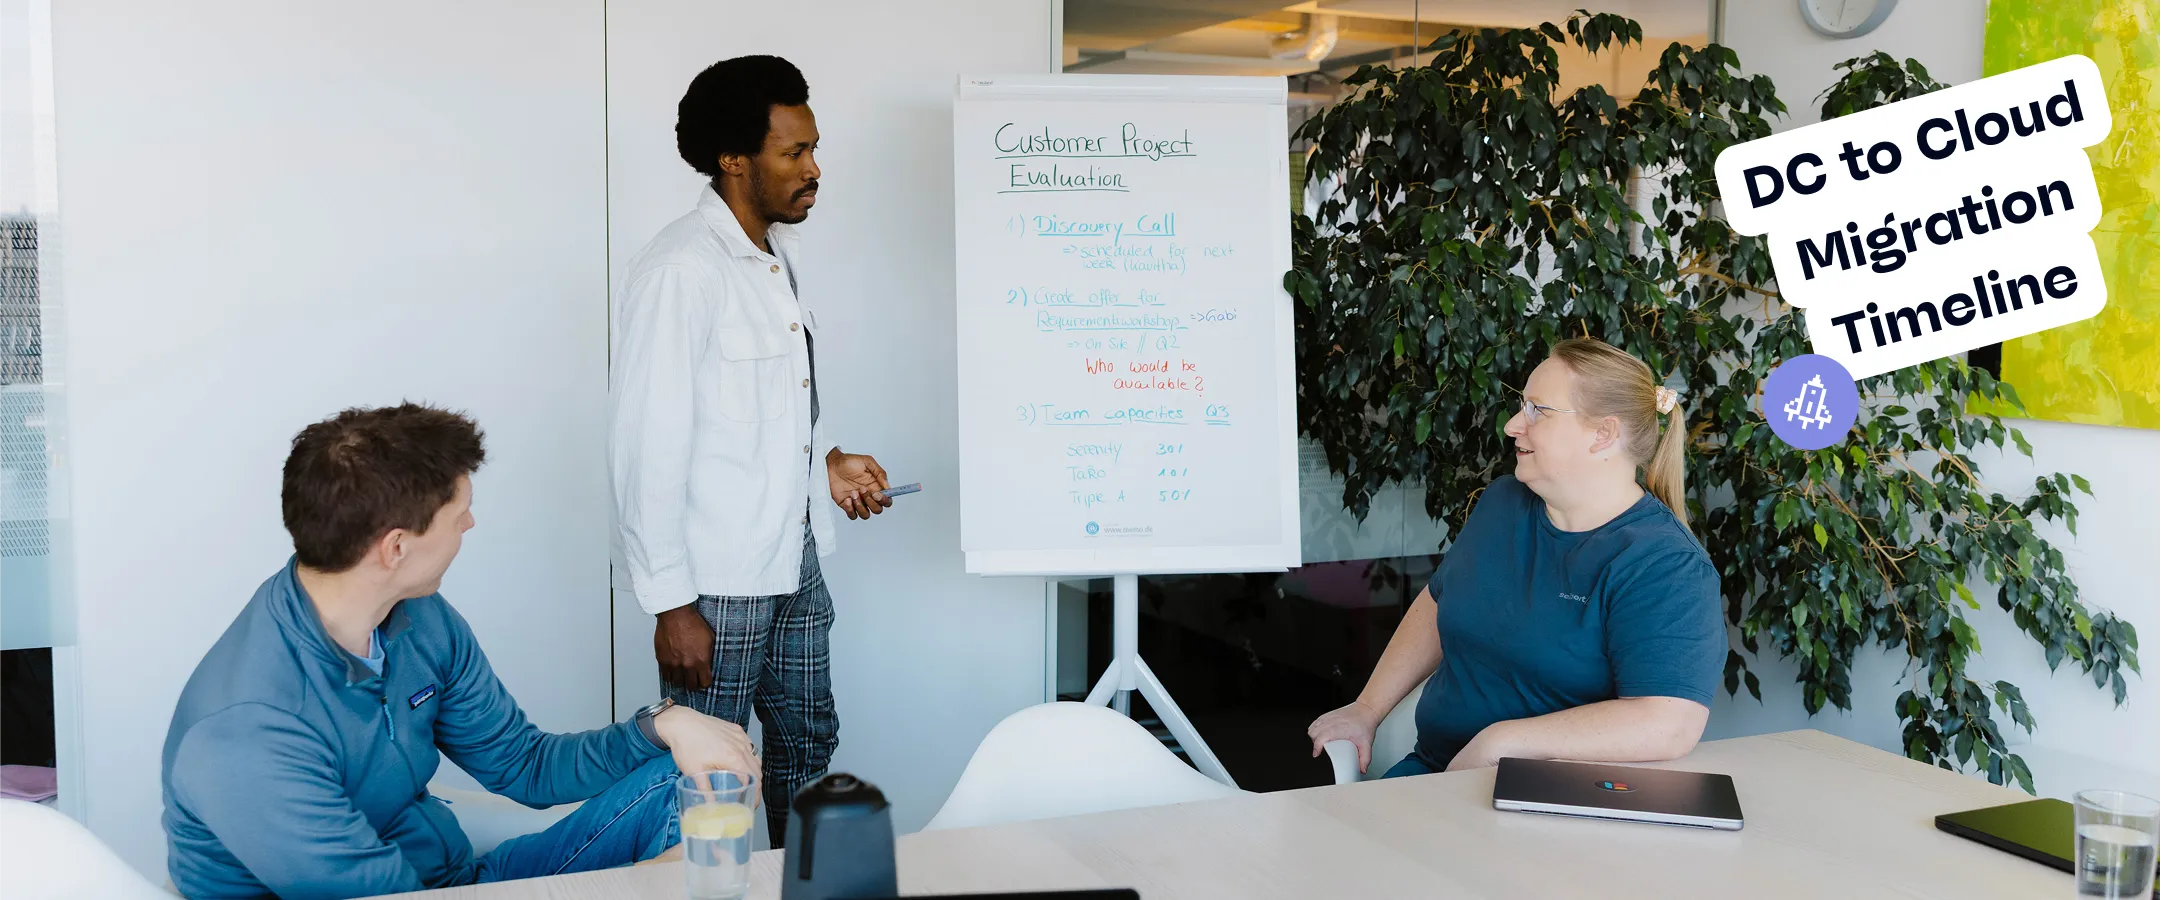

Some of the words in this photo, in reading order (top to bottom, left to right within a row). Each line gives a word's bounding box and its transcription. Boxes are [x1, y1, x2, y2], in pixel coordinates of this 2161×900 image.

[995, 123, 1107, 153] Customer
[1122, 123, 1193, 161] Project
[1011, 164, 1128, 188] Evaluation
[1033, 214, 1124, 246] Discovery
[1137, 212, 1175, 236] Call
[1080, 243, 1153, 259] scheduled
[1169, 242, 1188, 258] for
[1203, 244, 1235, 257] next
[1006, 286, 1028, 307] 2)
[1034, 286, 1075, 305] Create
[1089, 288, 1120, 306] offer
[1138, 288, 1161, 304] for
[1156, 335, 1181, 351] Q2
[1086, 357, 1114, 374] Who
[1129, 359, 1169, 373] would
[1182, 358, 1197, 372] be
[1016, 402, 1036, 425] 3)
[1041, 404, 1090, 420] Team
[1104, 404, 1184, 423] capacities
[1205, 403, 1230, 418] Q3
[1066, 441, 1122, 466] Serenity
[1117, 489, 1125, 503] A
